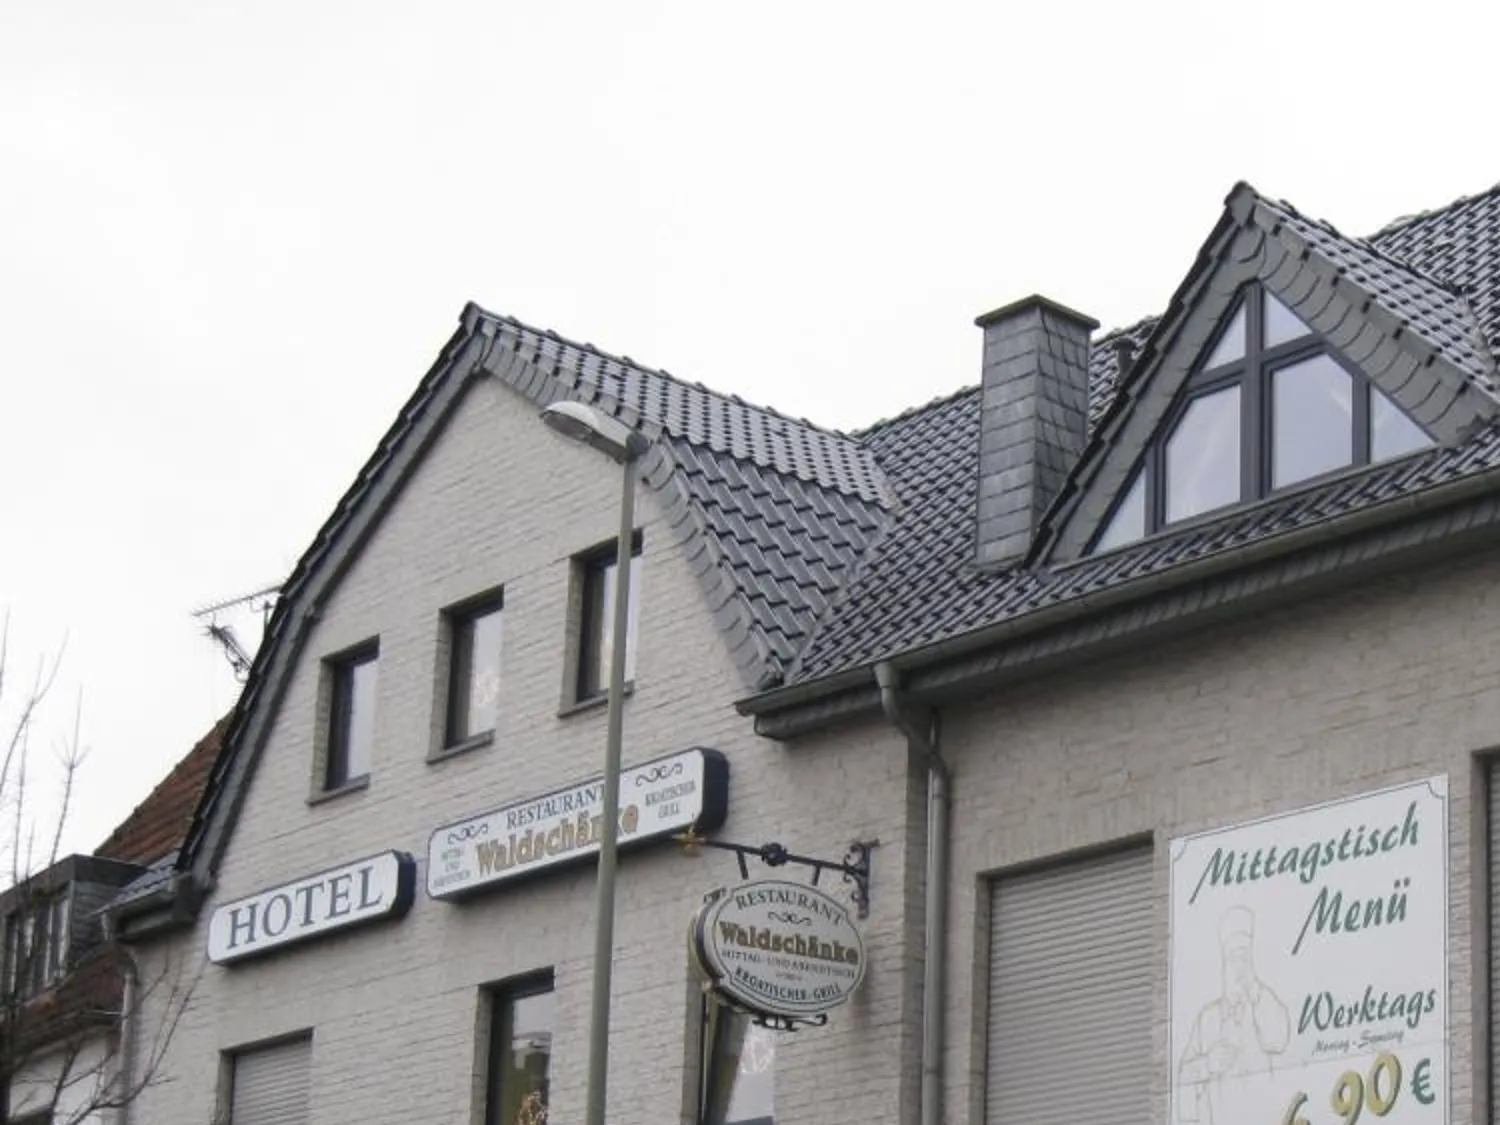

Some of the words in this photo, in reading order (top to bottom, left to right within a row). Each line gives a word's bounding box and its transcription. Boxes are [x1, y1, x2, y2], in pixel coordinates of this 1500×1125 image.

[1189, 801, 1418, 904] Mittagstisch
[227, 866, 383, 949] HOTEL
[736, 889, 844, 925] RESTAURANT
[1291, 878, 1411, 955] Menü
[719, 921, 859, 965] Waldschänke
[1298, 985, 1436, 1035] Werktags
